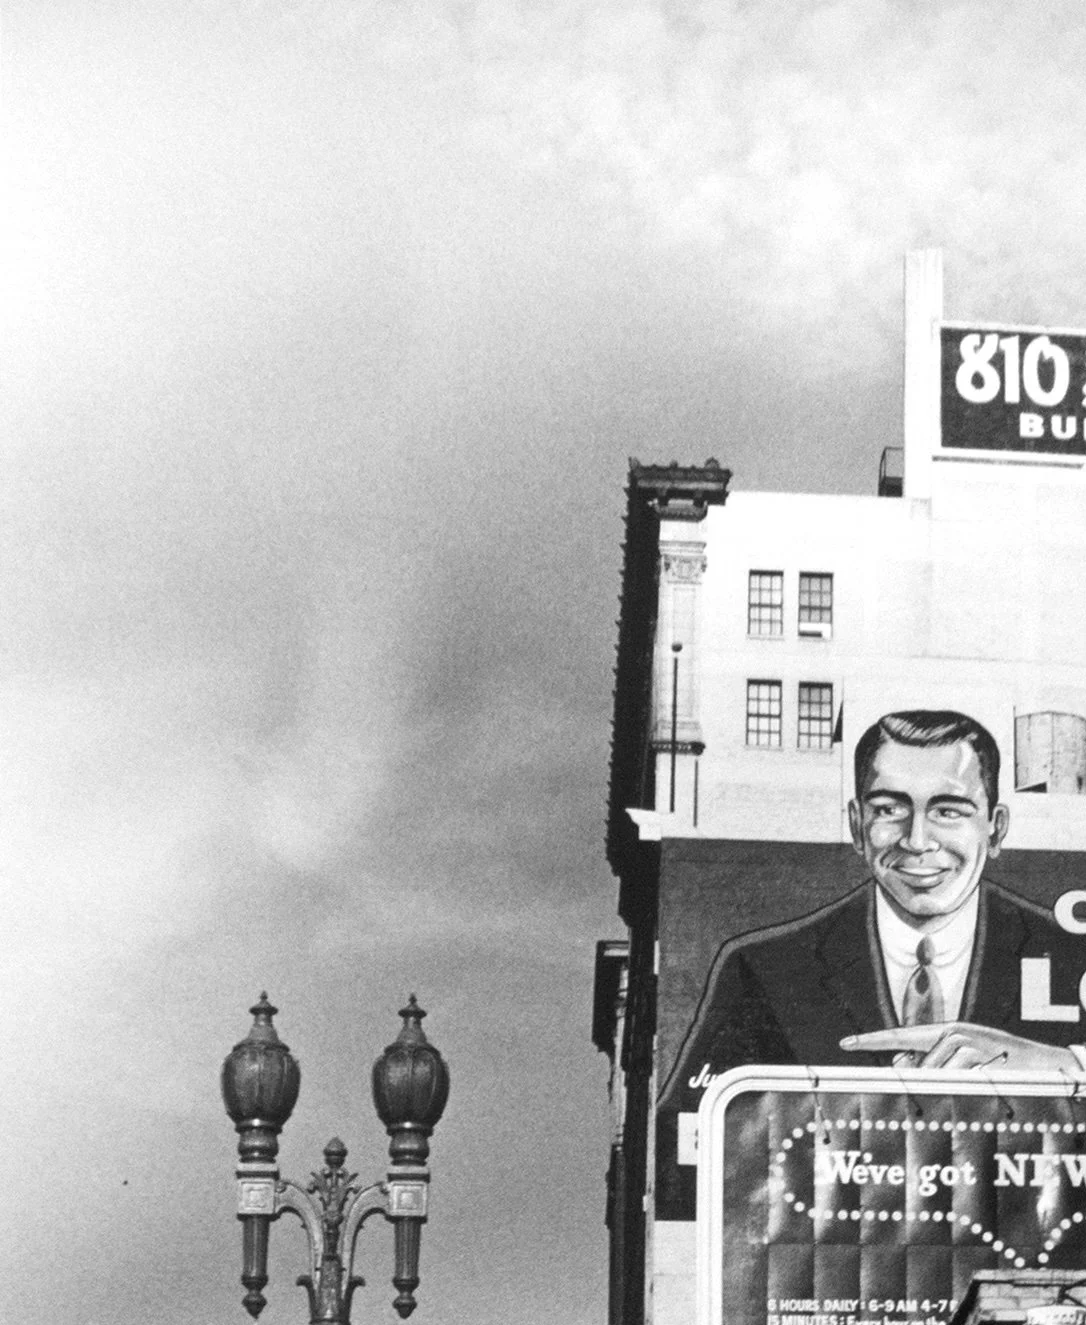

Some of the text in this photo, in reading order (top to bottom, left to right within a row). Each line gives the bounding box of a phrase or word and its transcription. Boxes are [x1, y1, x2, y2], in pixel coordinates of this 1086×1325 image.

[822, 1151, 904, 1185] We've
[919, 1161, 976, 1196] got
[779, 1299, 820, 1312] HOURS
